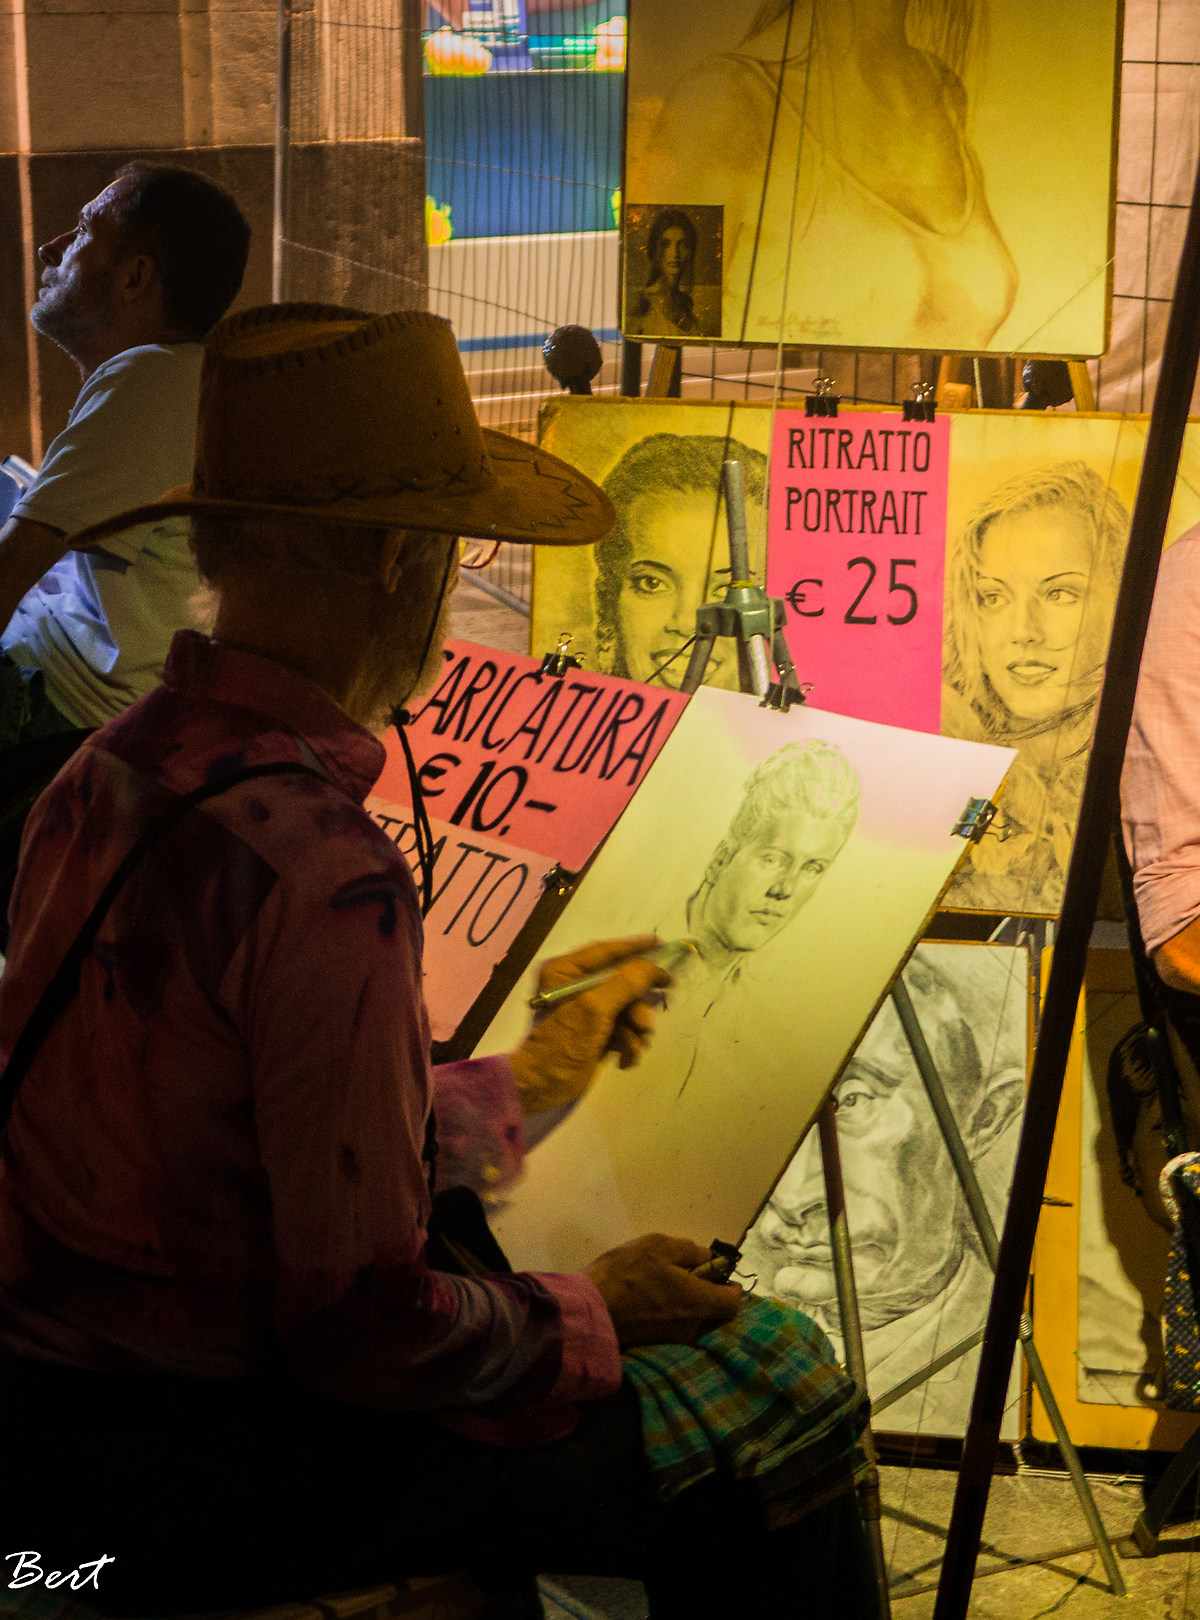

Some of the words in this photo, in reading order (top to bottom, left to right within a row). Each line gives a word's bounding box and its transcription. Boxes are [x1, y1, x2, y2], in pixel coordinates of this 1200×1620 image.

[787, 427, 931, 472] RITRATTO
[785, 486, 928, 535] PORTRAIT
[785, 578, 825, 617] €
[844, 556, 919, 626] 25
[411, 650, 671, 786] ARICATURA
[418, 752, 462, 798] €
